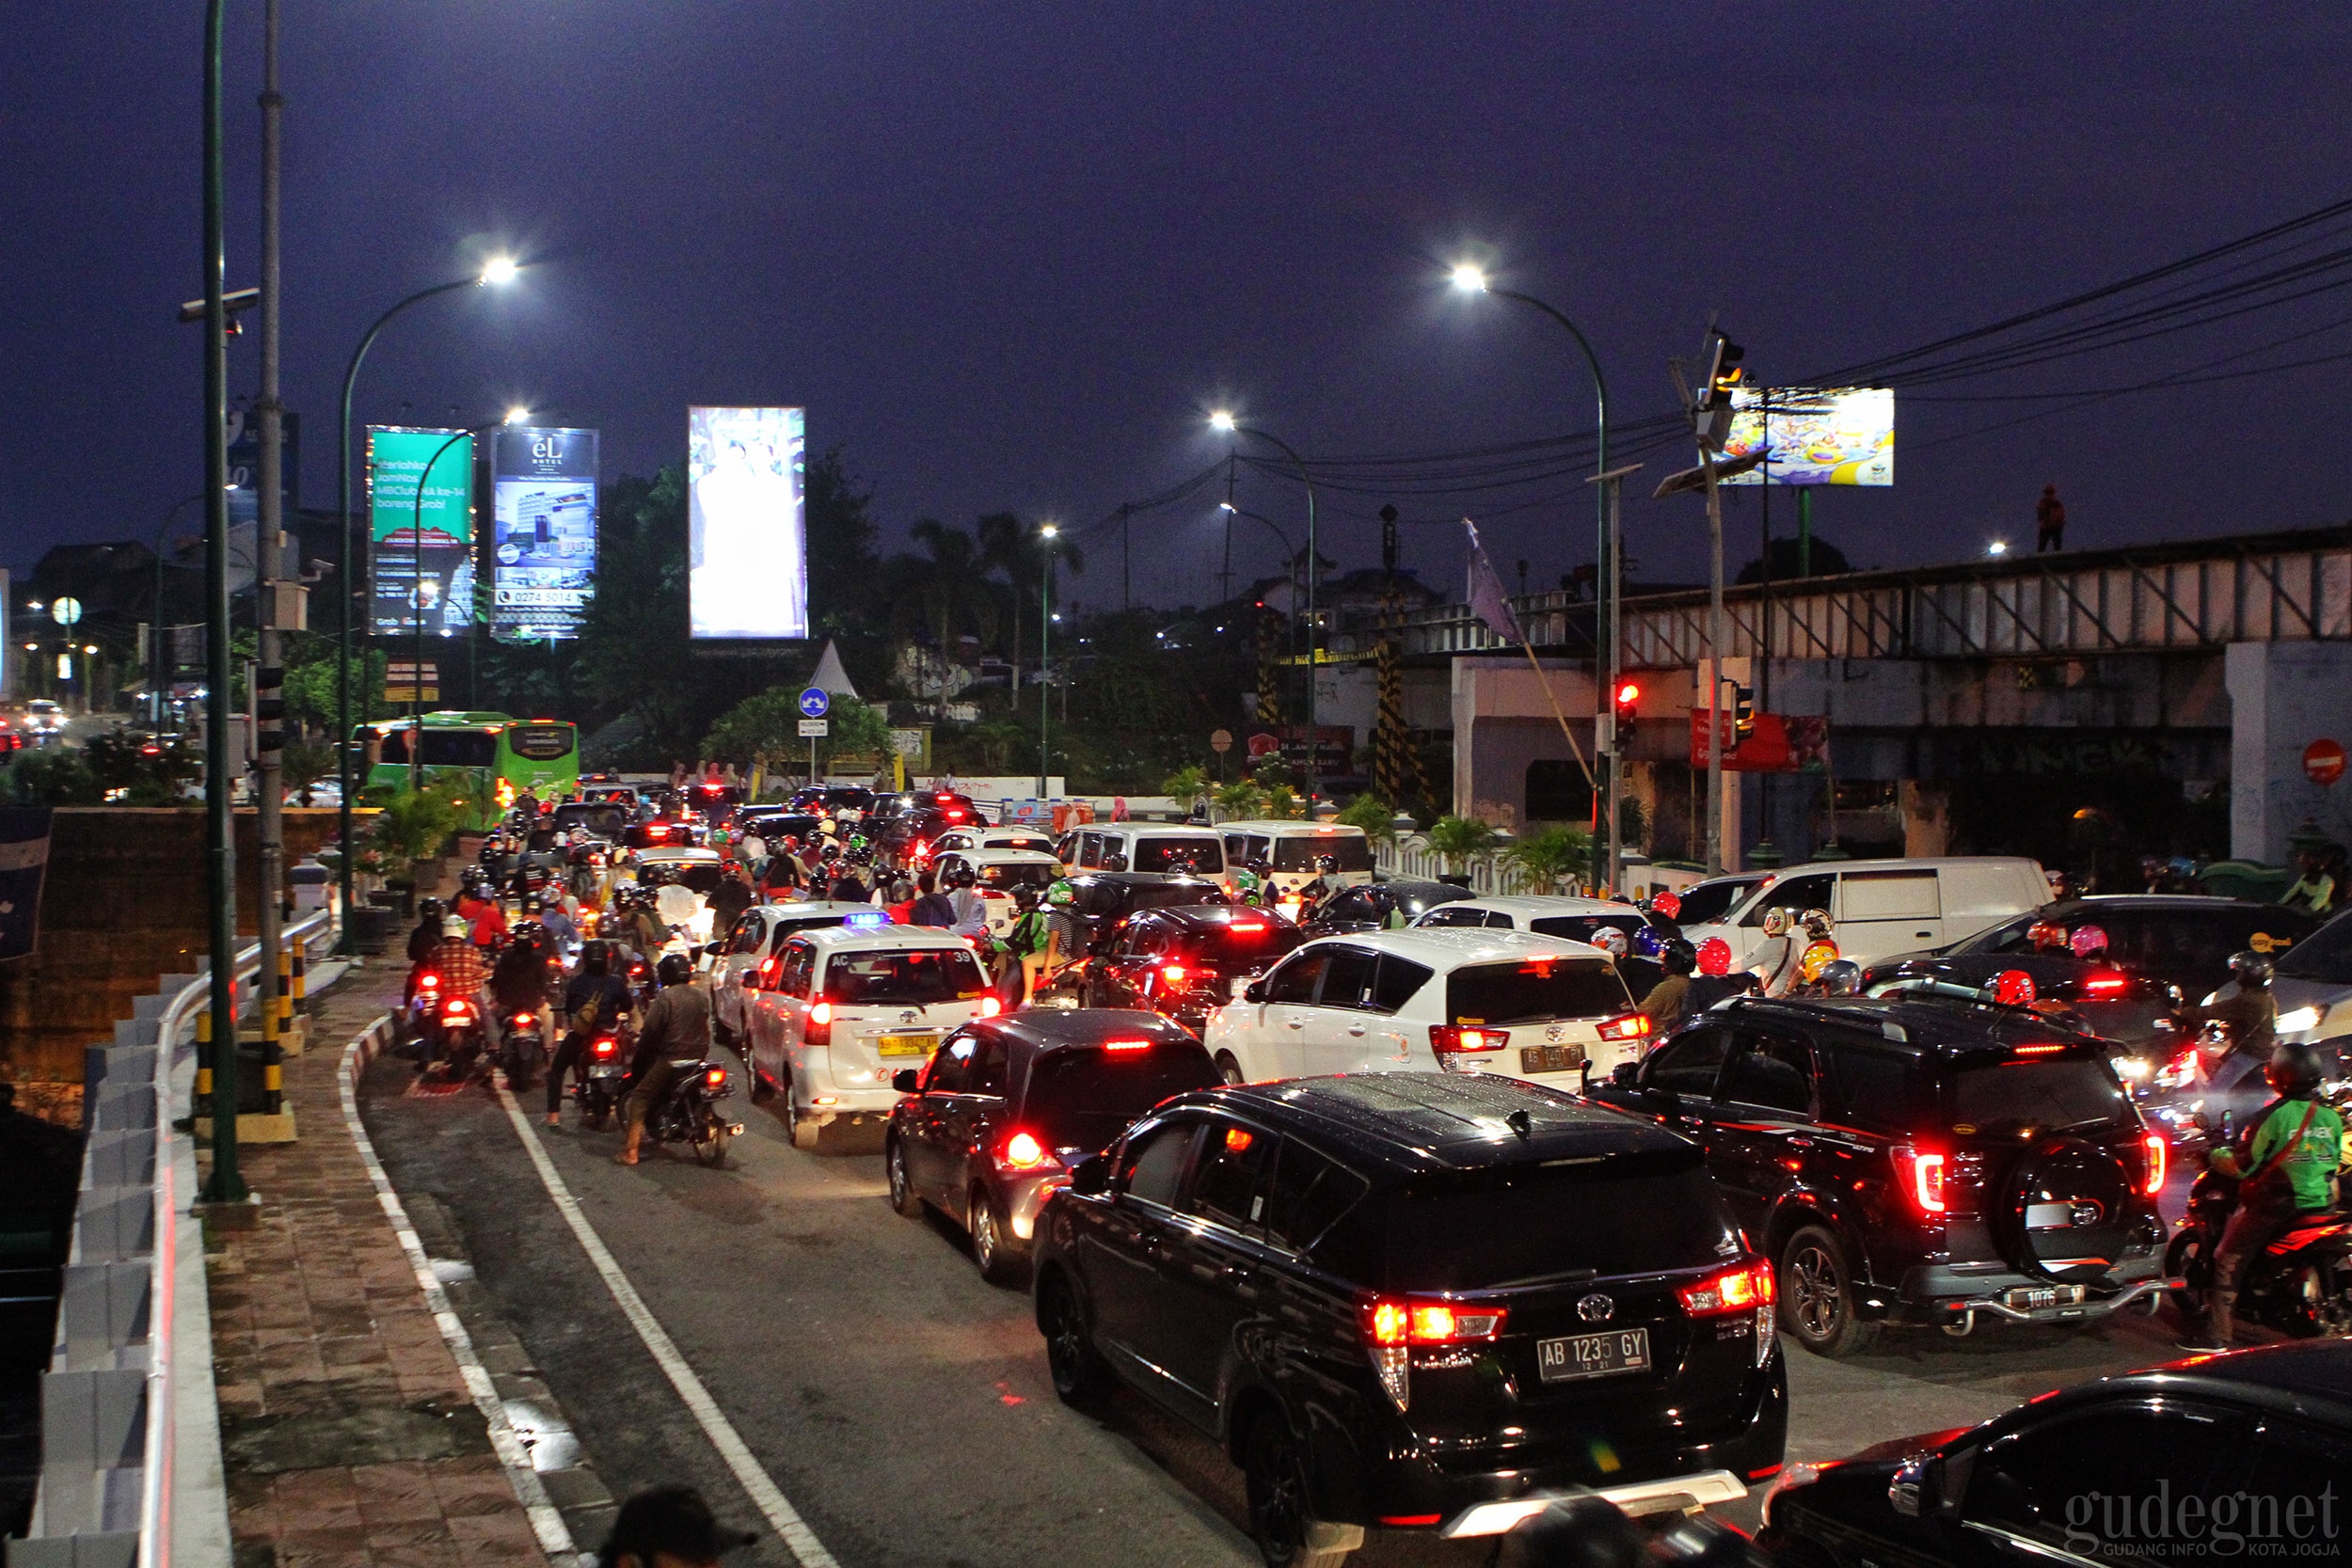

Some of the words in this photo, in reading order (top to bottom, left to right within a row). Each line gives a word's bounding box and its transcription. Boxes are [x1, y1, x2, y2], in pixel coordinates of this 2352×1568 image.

[532, 437, 563, 458] éL
[516, 593, 541, 602] 0274
[546, 594, 571, 603] 5014
[833, 956, 849, 967] AC
[954, 952, 971, 962] 39
[2027, 1290, 2057, 1308] 1076
[1545, 1342, 1565, 1366] AB
[1572, 1337, 1613, 1363] 1235
[1620, 1332, 1642, 1356] GY
